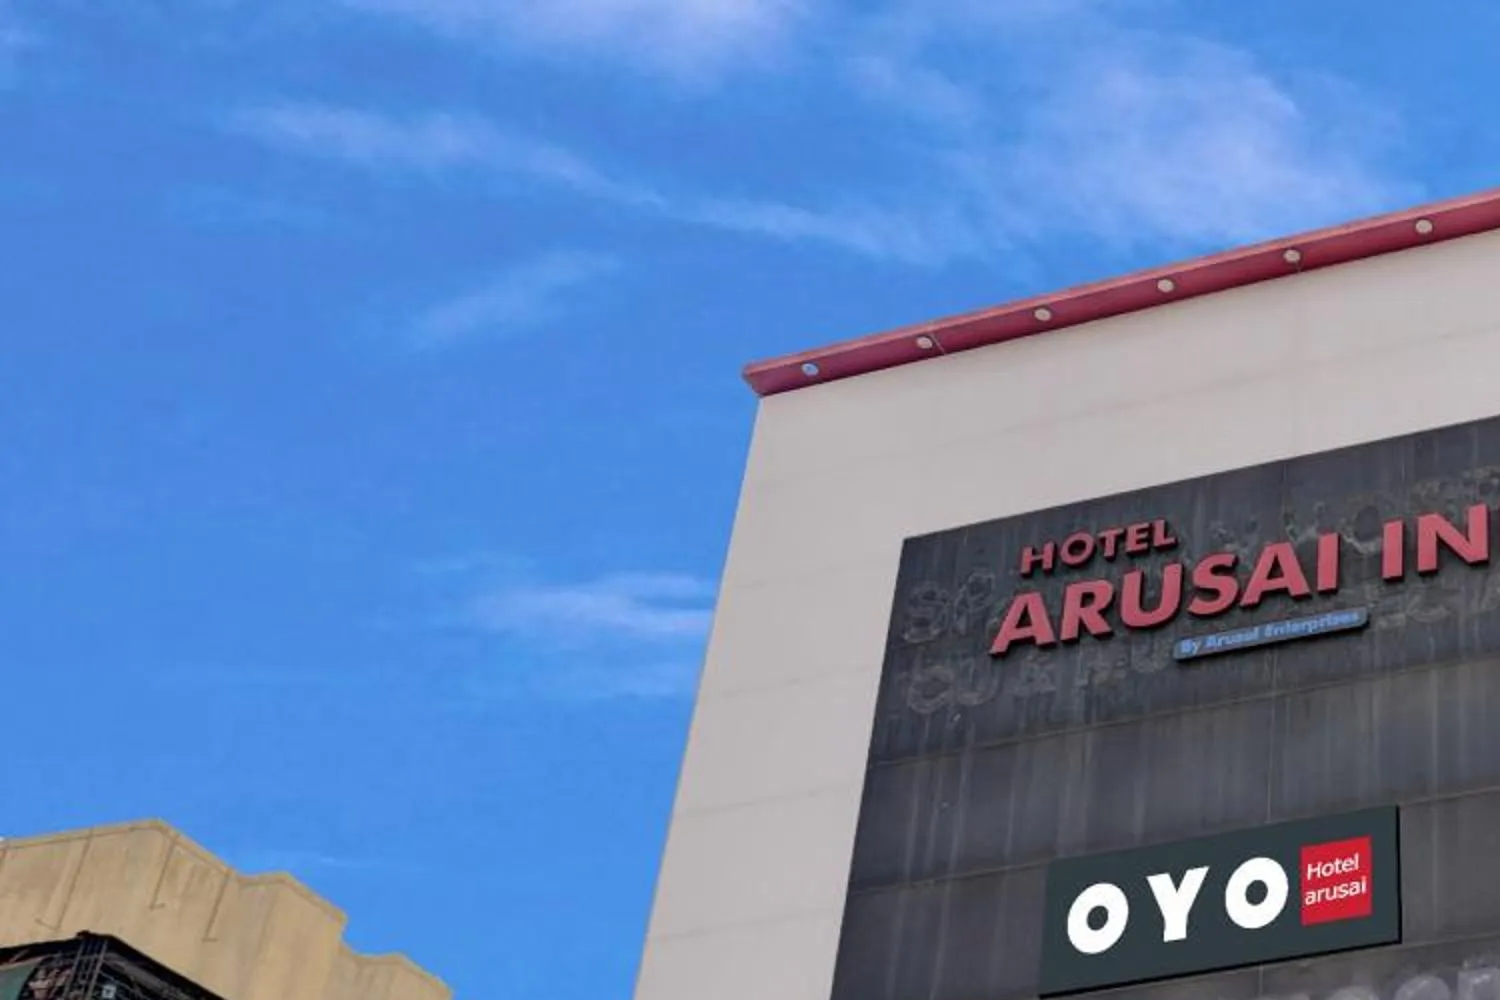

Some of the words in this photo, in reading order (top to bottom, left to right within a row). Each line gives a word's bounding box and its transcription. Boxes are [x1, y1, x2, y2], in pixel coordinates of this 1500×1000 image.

[1020, 518, 1178, 576] HOTEL
[989, 532, 1340, 655] ARUSAI
[1180, 638, 1200, 655] By
[1306, 851, 1360, 880] Hotel
[1067, 857, 1289, 954] OYO
[1304, 875, 1368, 906] arusai
